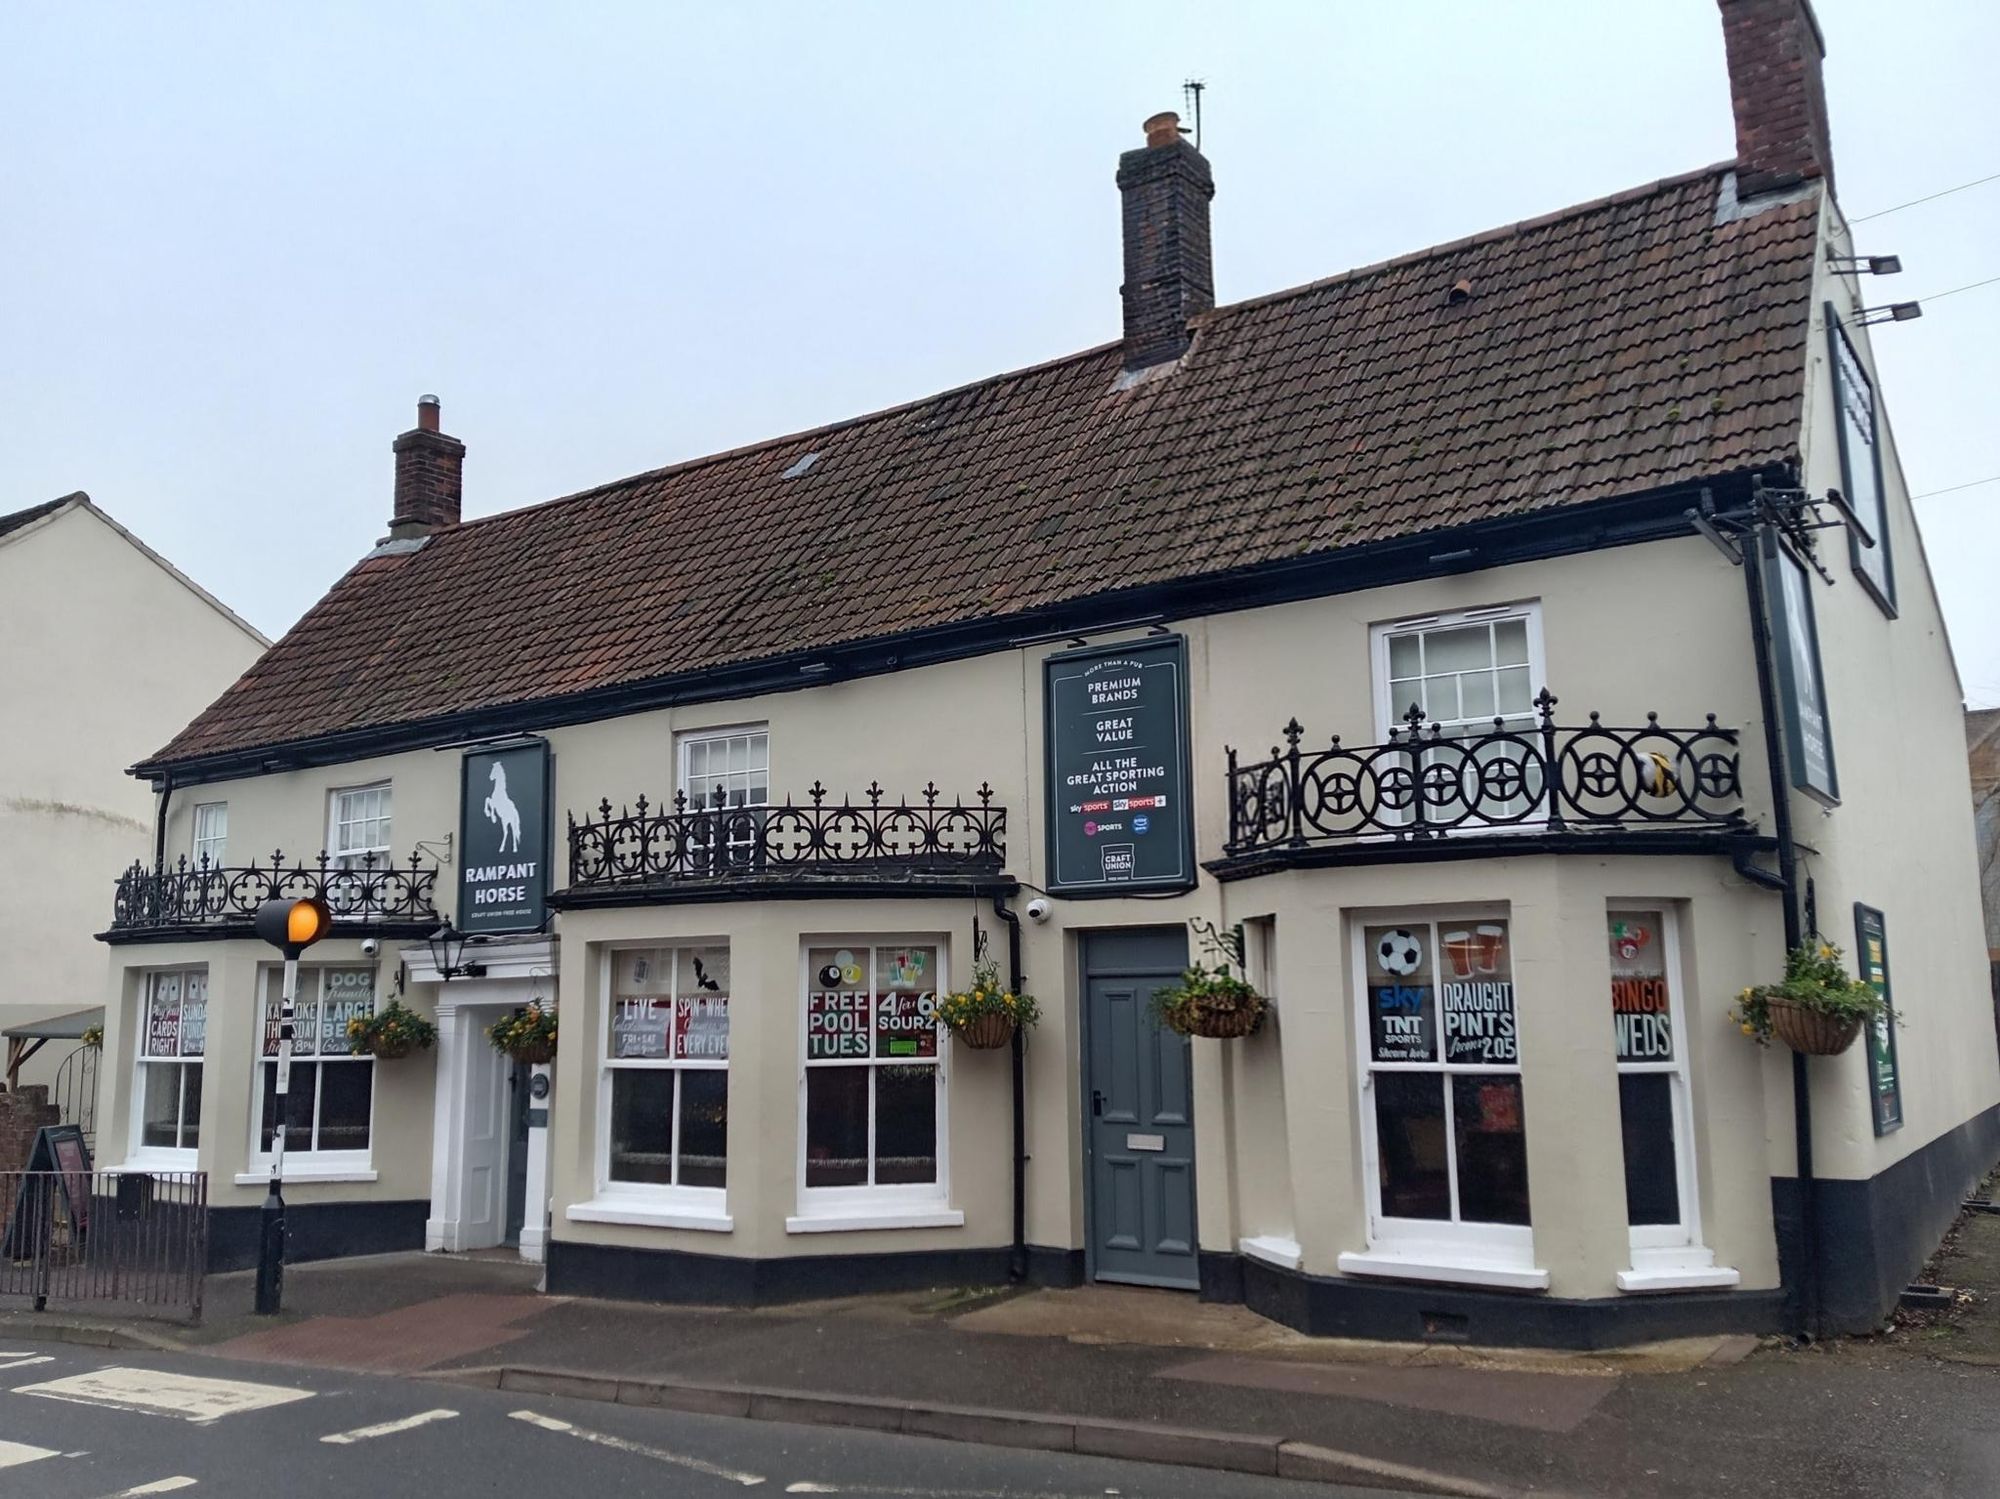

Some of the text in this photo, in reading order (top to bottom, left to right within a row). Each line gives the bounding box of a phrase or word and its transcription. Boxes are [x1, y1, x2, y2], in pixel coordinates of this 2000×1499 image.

[1084, 663, 1102, 677] MORE
[1130, 660, 1143, 669] PUB
[1088, 677, 1141, 693] PREMIUM
[1092, 689, 1138, 704] BRANDS
[1096, 717, 1133, 731] GREAT
[1096, 730, 1133, 742] VALUE
[1092, 757, 1137, 771] ALL THE
[1067, 766, 1164, 785] GREAT SPORTING
[1093, 781, 1137, 794] ACTION
[1083, 802, 1108, 812] sports
[1105, 854, 1131, 863] CRAFT
[1105, 862, 1131, 870] UNION
[466, 862, 537, 883] RAMPANT
[475, 886, 526, 904] HORSE
[331, 973, 370, 986] DOG
[810, 991, 868, 1011] FREE
[878, 991, 897, 1016] 4
[917, 991, 935, 1016] 6
[1379, 982, 1425, 1014] sky
[1443, 982, 1511, 1012] DRAUGHT
[267, 1002, 316, 1020] KAOKE
[324, 1002, 373, 1021] LARGE
[624, 998, 657, 1020] LIVE
[151, 1021, 177, 1037] CARDS
[266, 1021, 315, 1039] THSDAY
[322, 1023, 347, 1038] BE
[809, 1012, 868, 1033] POOL
[878, 1016, 936, 1030] SOURZ
[1381, 1016, 1424, 1034] TNT
[1445, 1012, 1515, 1037] PINTS
[809, 1033, 868, 1054] TUES
[1385, 1034, 1422, 1044] SPORTS
[1616, 1014, 1671, 1057] WEDS
[151, 1038, 175, 1054] RIGHT
